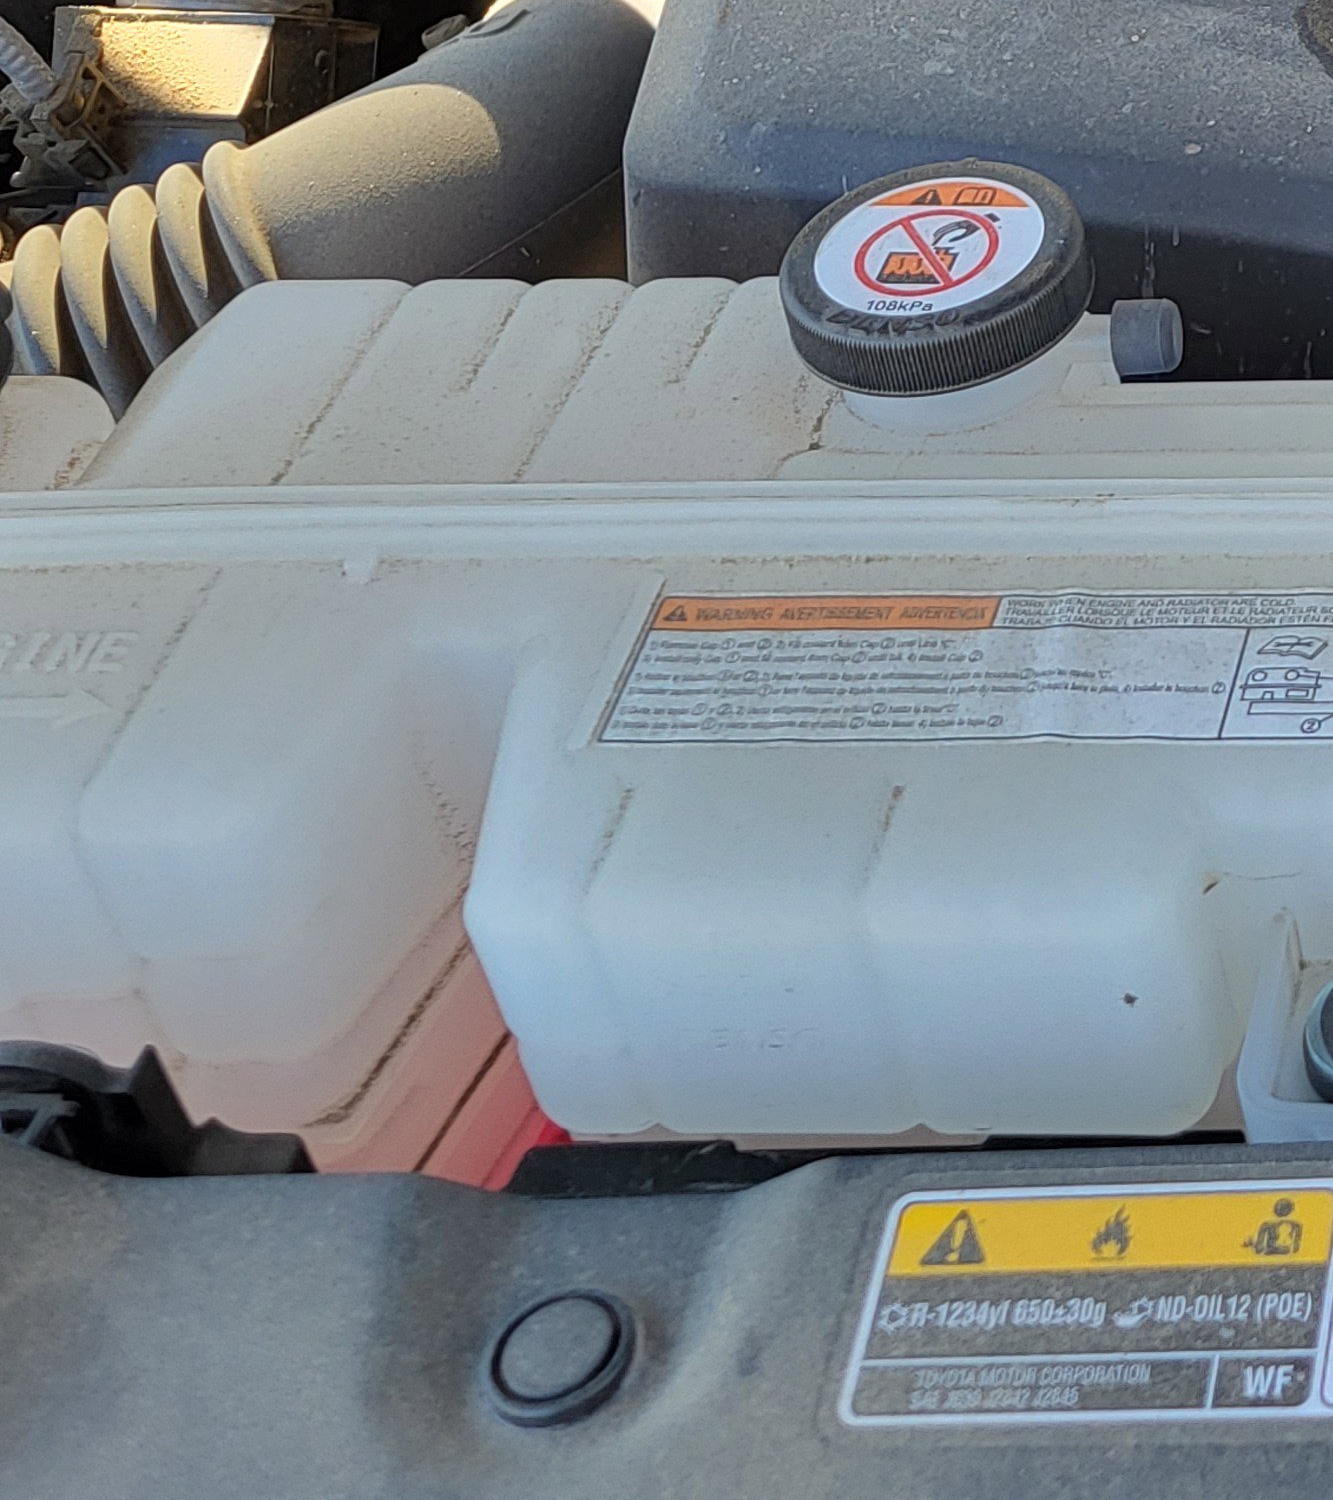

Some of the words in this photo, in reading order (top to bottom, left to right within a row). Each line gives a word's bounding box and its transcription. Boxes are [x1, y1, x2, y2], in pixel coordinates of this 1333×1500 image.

[865, 298, 934, 313] 108kPa
[1089, 598, 1136, 608] ENGINE
[1138, 598, 1165, 608] AND
[695, 605, 773, 621] WARNING
[1248, 607, 1319, 616] RADIATEUR
[909, 1297, 1011, 1332] R-1234yf
[1011, 1296, 1108, 1329] 650±30g
[1256, 1291, 1314, 1323] (POE)
[917, 1369, 977, 1388] TOYOTA
[979, 1366, 1037, 1386] MOTOR
[1039, 1363, 1152, 1386] CORPORATION
[1243, 1364, 1295, 1400] WF
